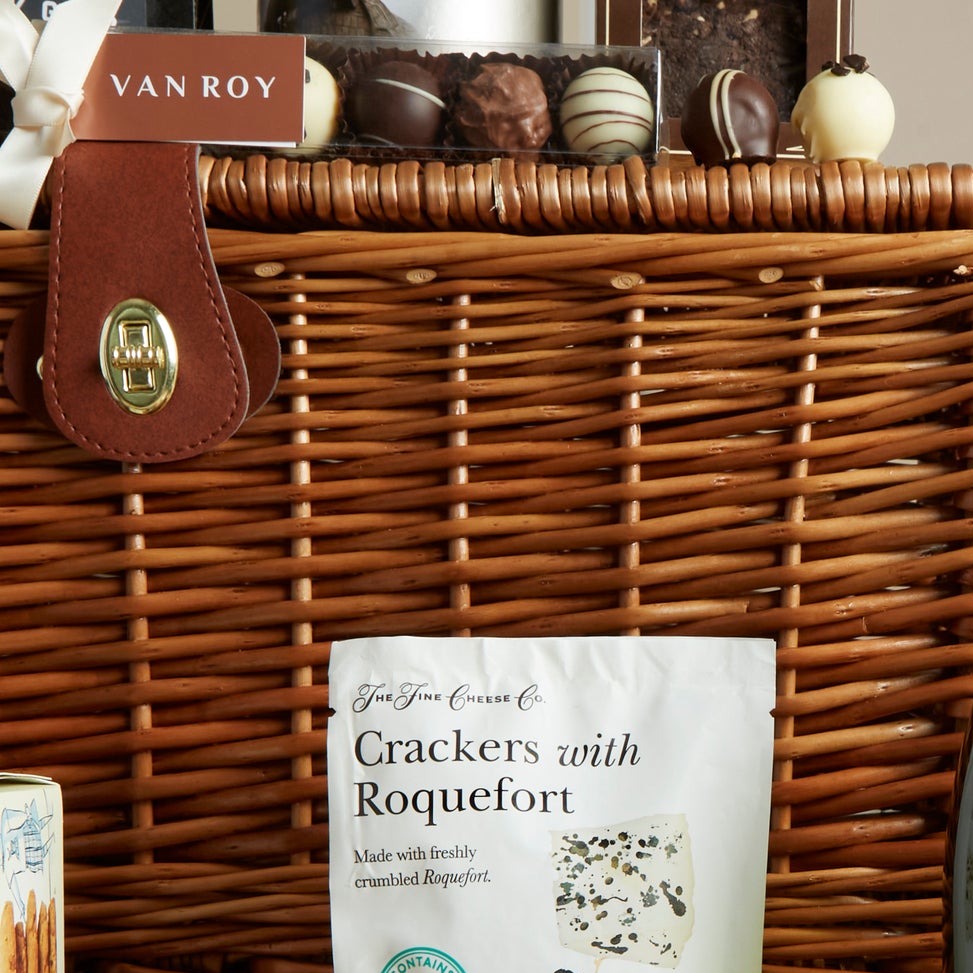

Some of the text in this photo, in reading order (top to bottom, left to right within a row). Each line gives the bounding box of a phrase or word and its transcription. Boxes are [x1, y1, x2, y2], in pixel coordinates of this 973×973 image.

[110, 74, 276, 98] VAN ROY
[354, 729, 641, 768] Crackers with
[353, 777, 575, 827] Roquefort
[354, 845, 477, 864] Made with freshly
[354, 867, 491, 889] crumbled Roquefort.
